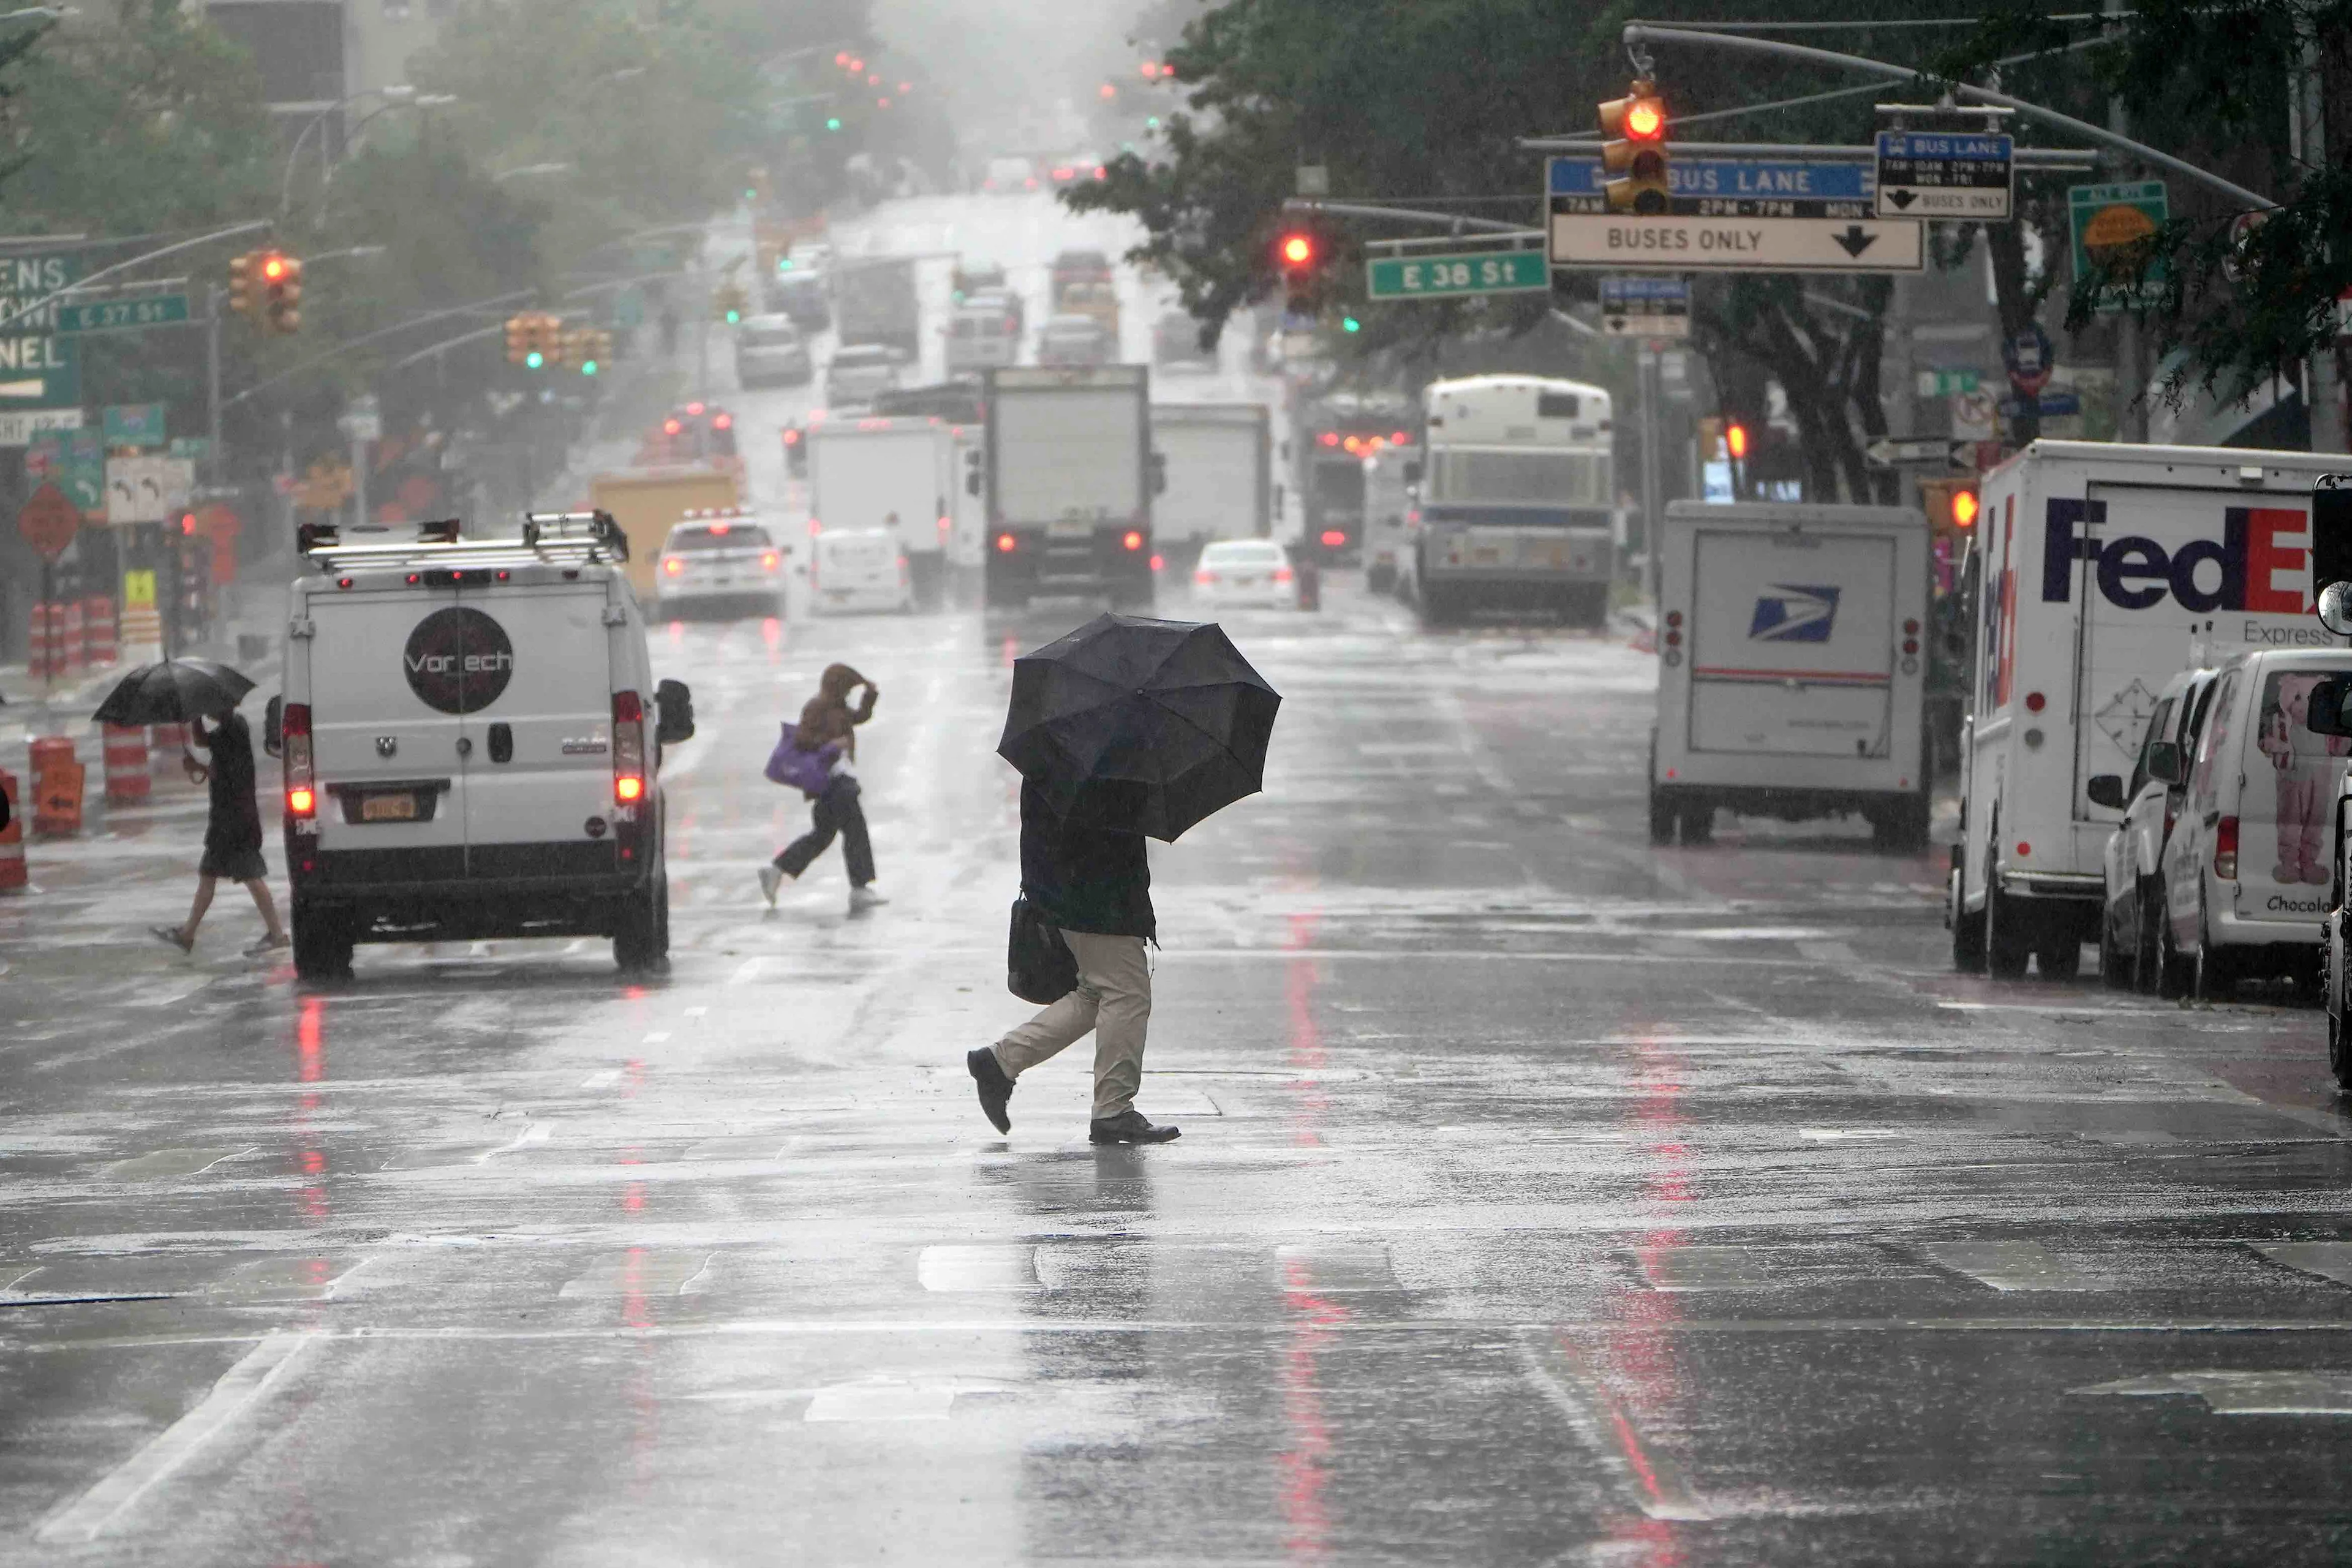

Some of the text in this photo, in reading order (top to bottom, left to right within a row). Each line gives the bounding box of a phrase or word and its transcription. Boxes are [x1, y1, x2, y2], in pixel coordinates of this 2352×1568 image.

[1914, 140, 2000, 154] BUS LANE
[1666, 169, 1811, 193] BUS LANE
[1922, 194, 2002, 209] BUSES ONLY
[1607, 227, 1762, 251] BUSES ONLY
[1403, 265, 1421, 288] E
[1482, 260, 1516, 284] St
[2043, 497, 2318, 614] FedE
[2244, 620, 2333, 646] Express
